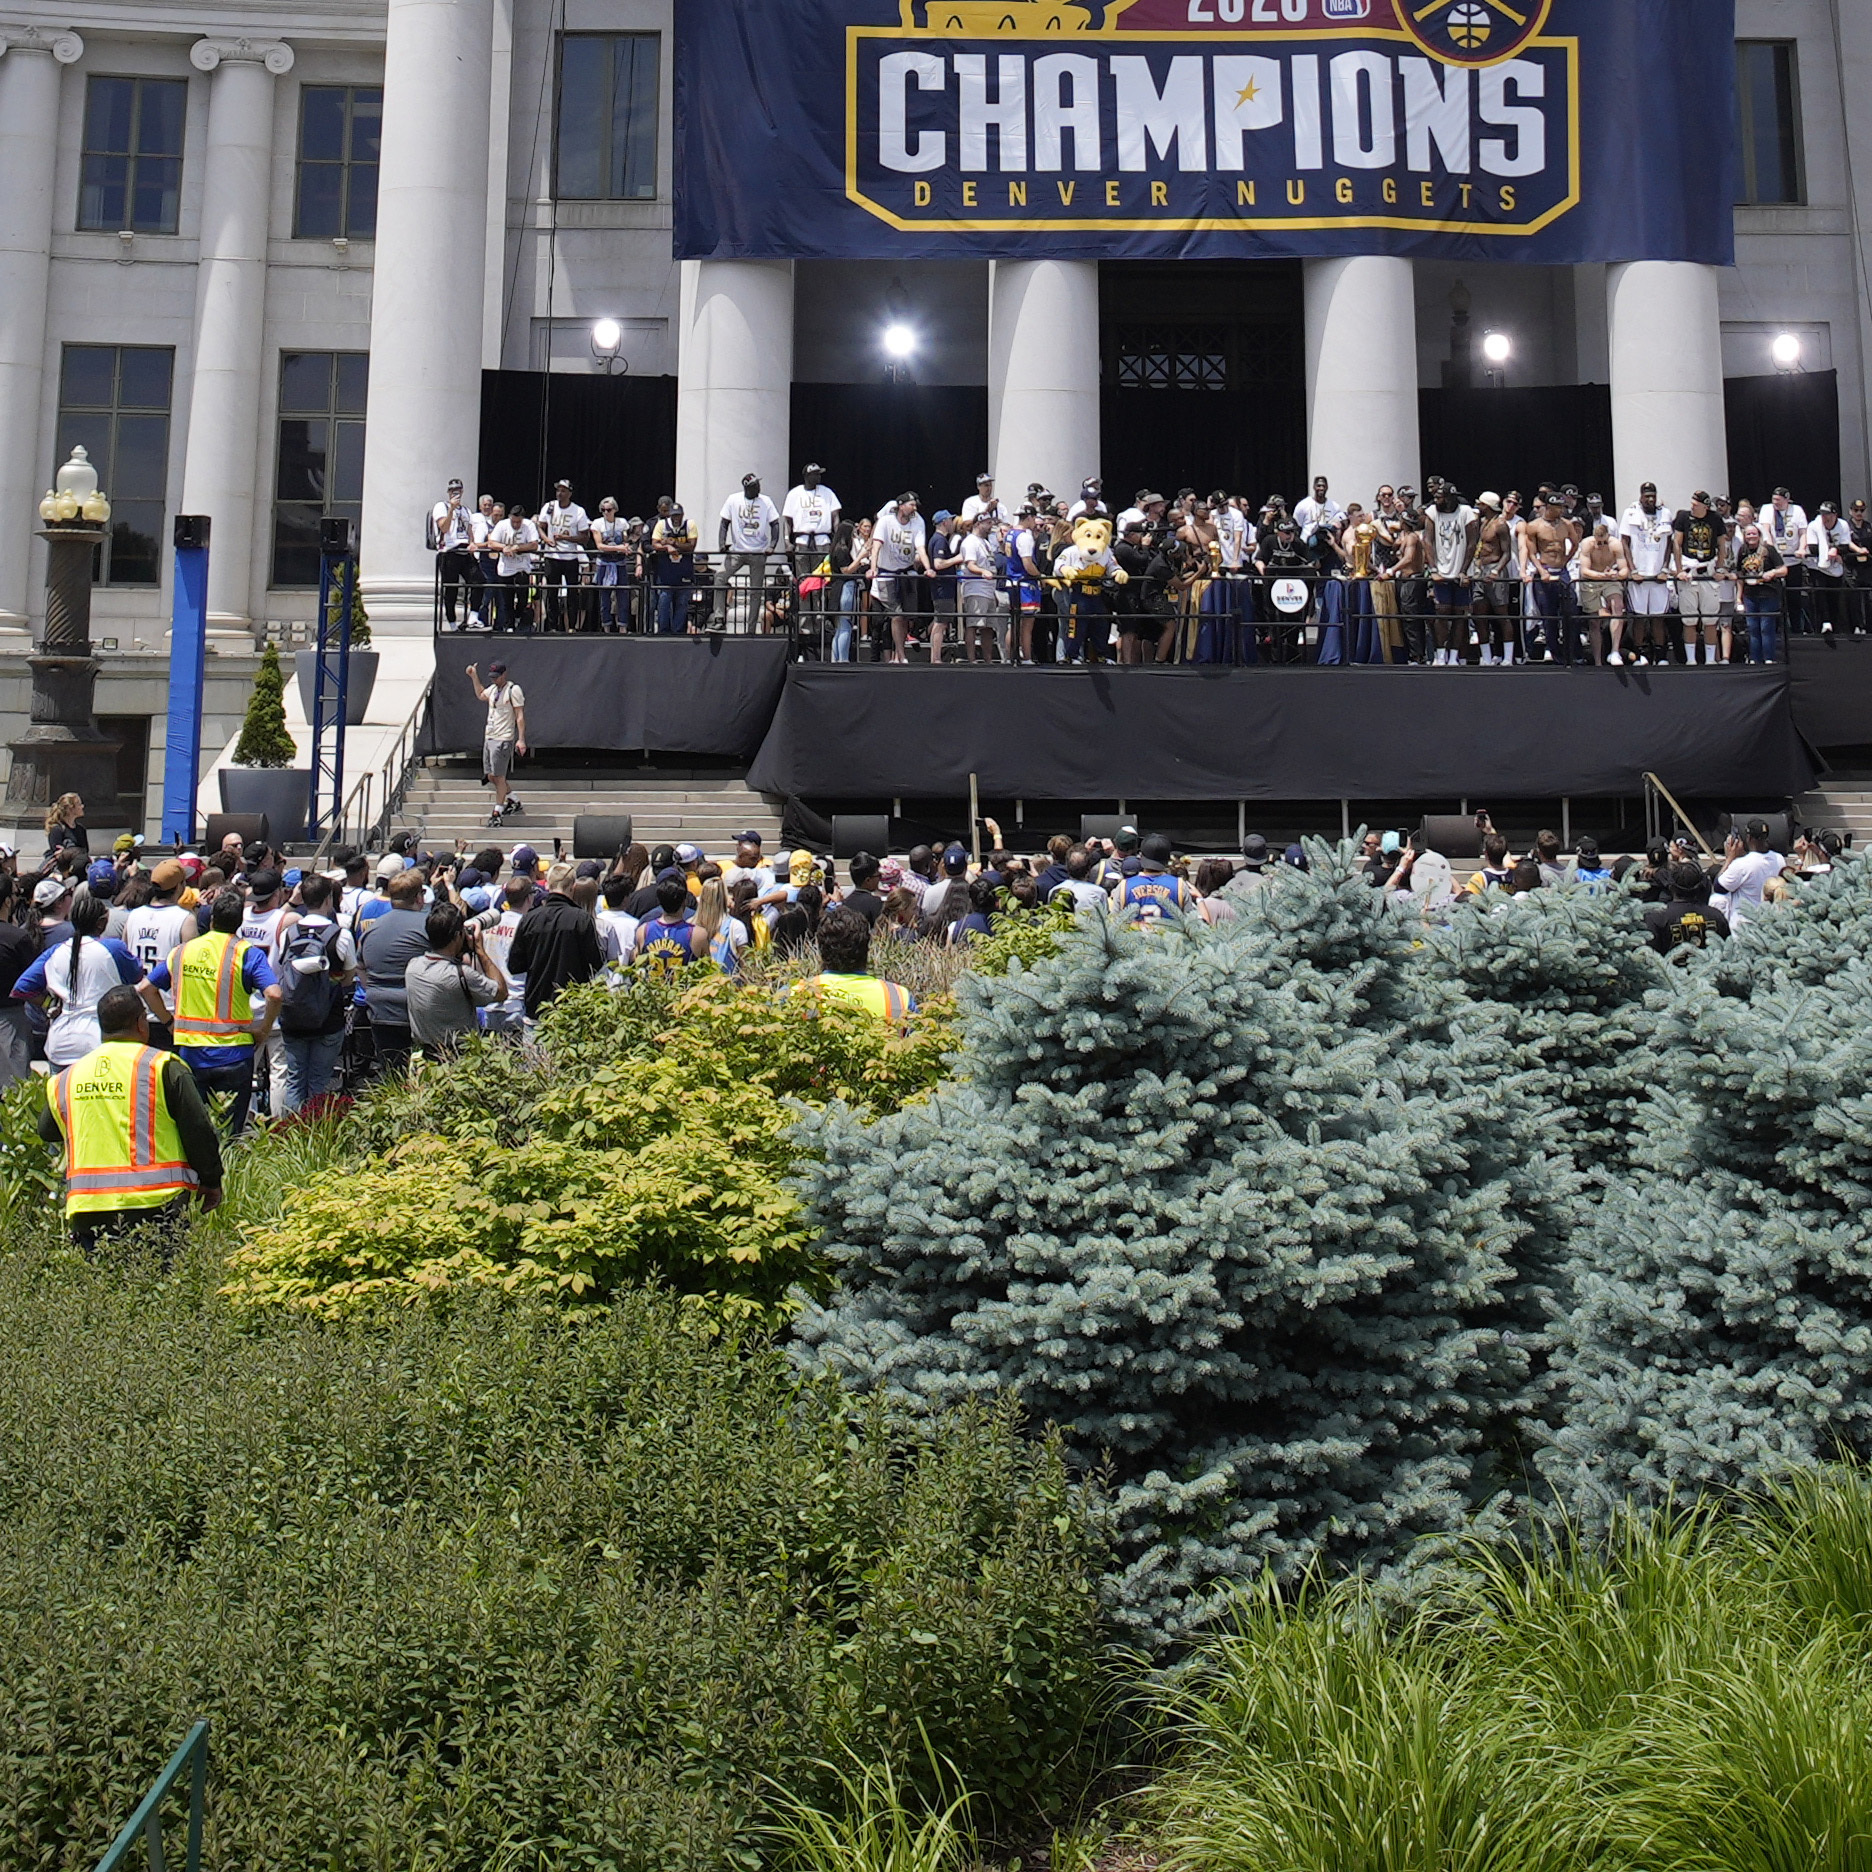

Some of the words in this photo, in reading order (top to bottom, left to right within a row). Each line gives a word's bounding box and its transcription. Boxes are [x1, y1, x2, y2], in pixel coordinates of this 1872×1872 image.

[879, 50, 1545, 177] CHAMPIONS
[914, 180, 1169, 207] DENVER
[1237, 178, 1516, 211] NUGGETS
[646, 938, 686, 957] MURRAY
[183, 964, 217, 976] DENVER
[76, 1082, 123, 1093] DENVER
